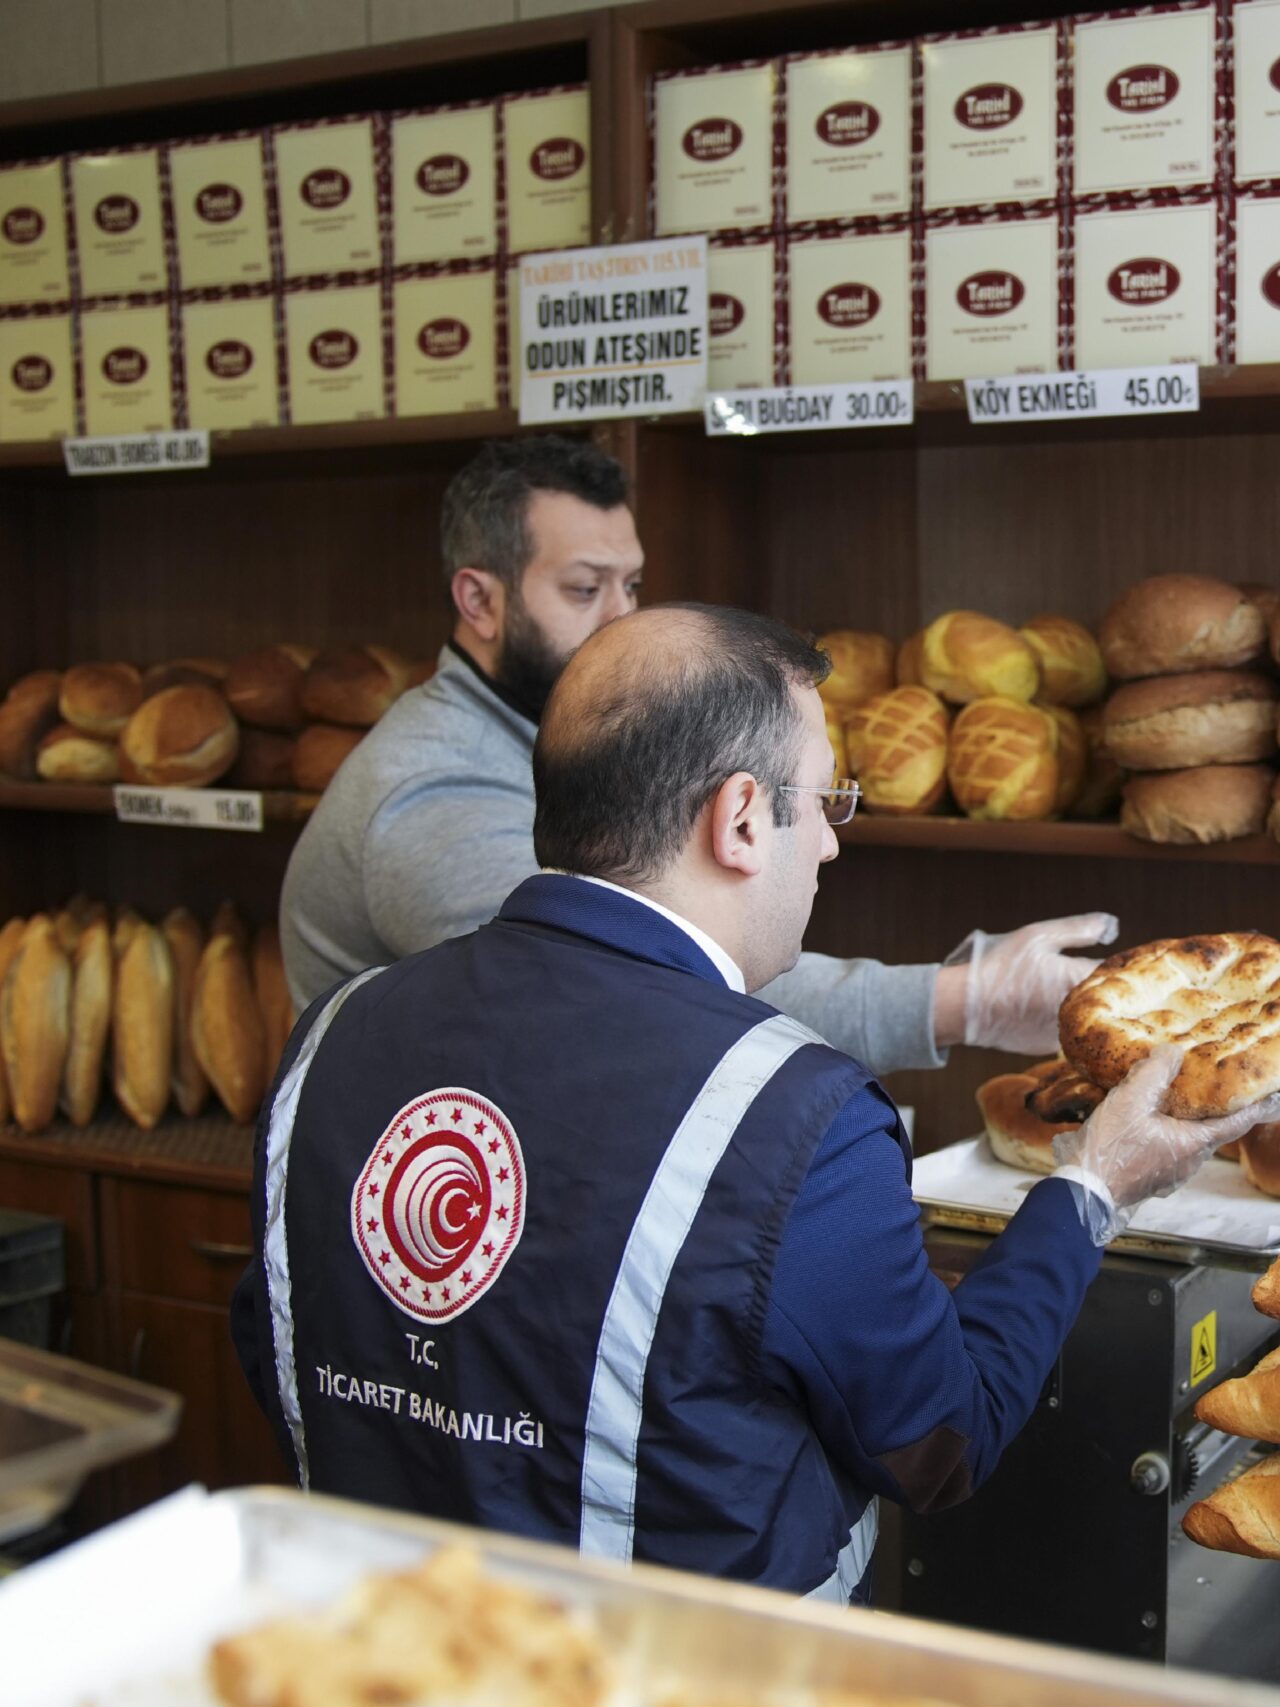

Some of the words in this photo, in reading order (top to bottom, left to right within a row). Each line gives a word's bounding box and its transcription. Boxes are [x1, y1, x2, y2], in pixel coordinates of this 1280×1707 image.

[538, 285, 689, 329] ÜRÜNLERİMİZ
[527, 337, 586, 371] ODUN
[594, 327, 702, 366] ATEŞİNDE
[553, 373, 673, 411] PİŞMİŞTİR.
[759, 390, 833, 426] BUĞDAY
[972, 379, 1011, 415] KÖY
[1018, 374, 1097, 413] EKMEĞİ
[405, 1333, 439, 1370] T.C.
[316, 1364, 406, 1414] TİCARET
[409, 1392, 544, 1448] BAKANLIĞI
